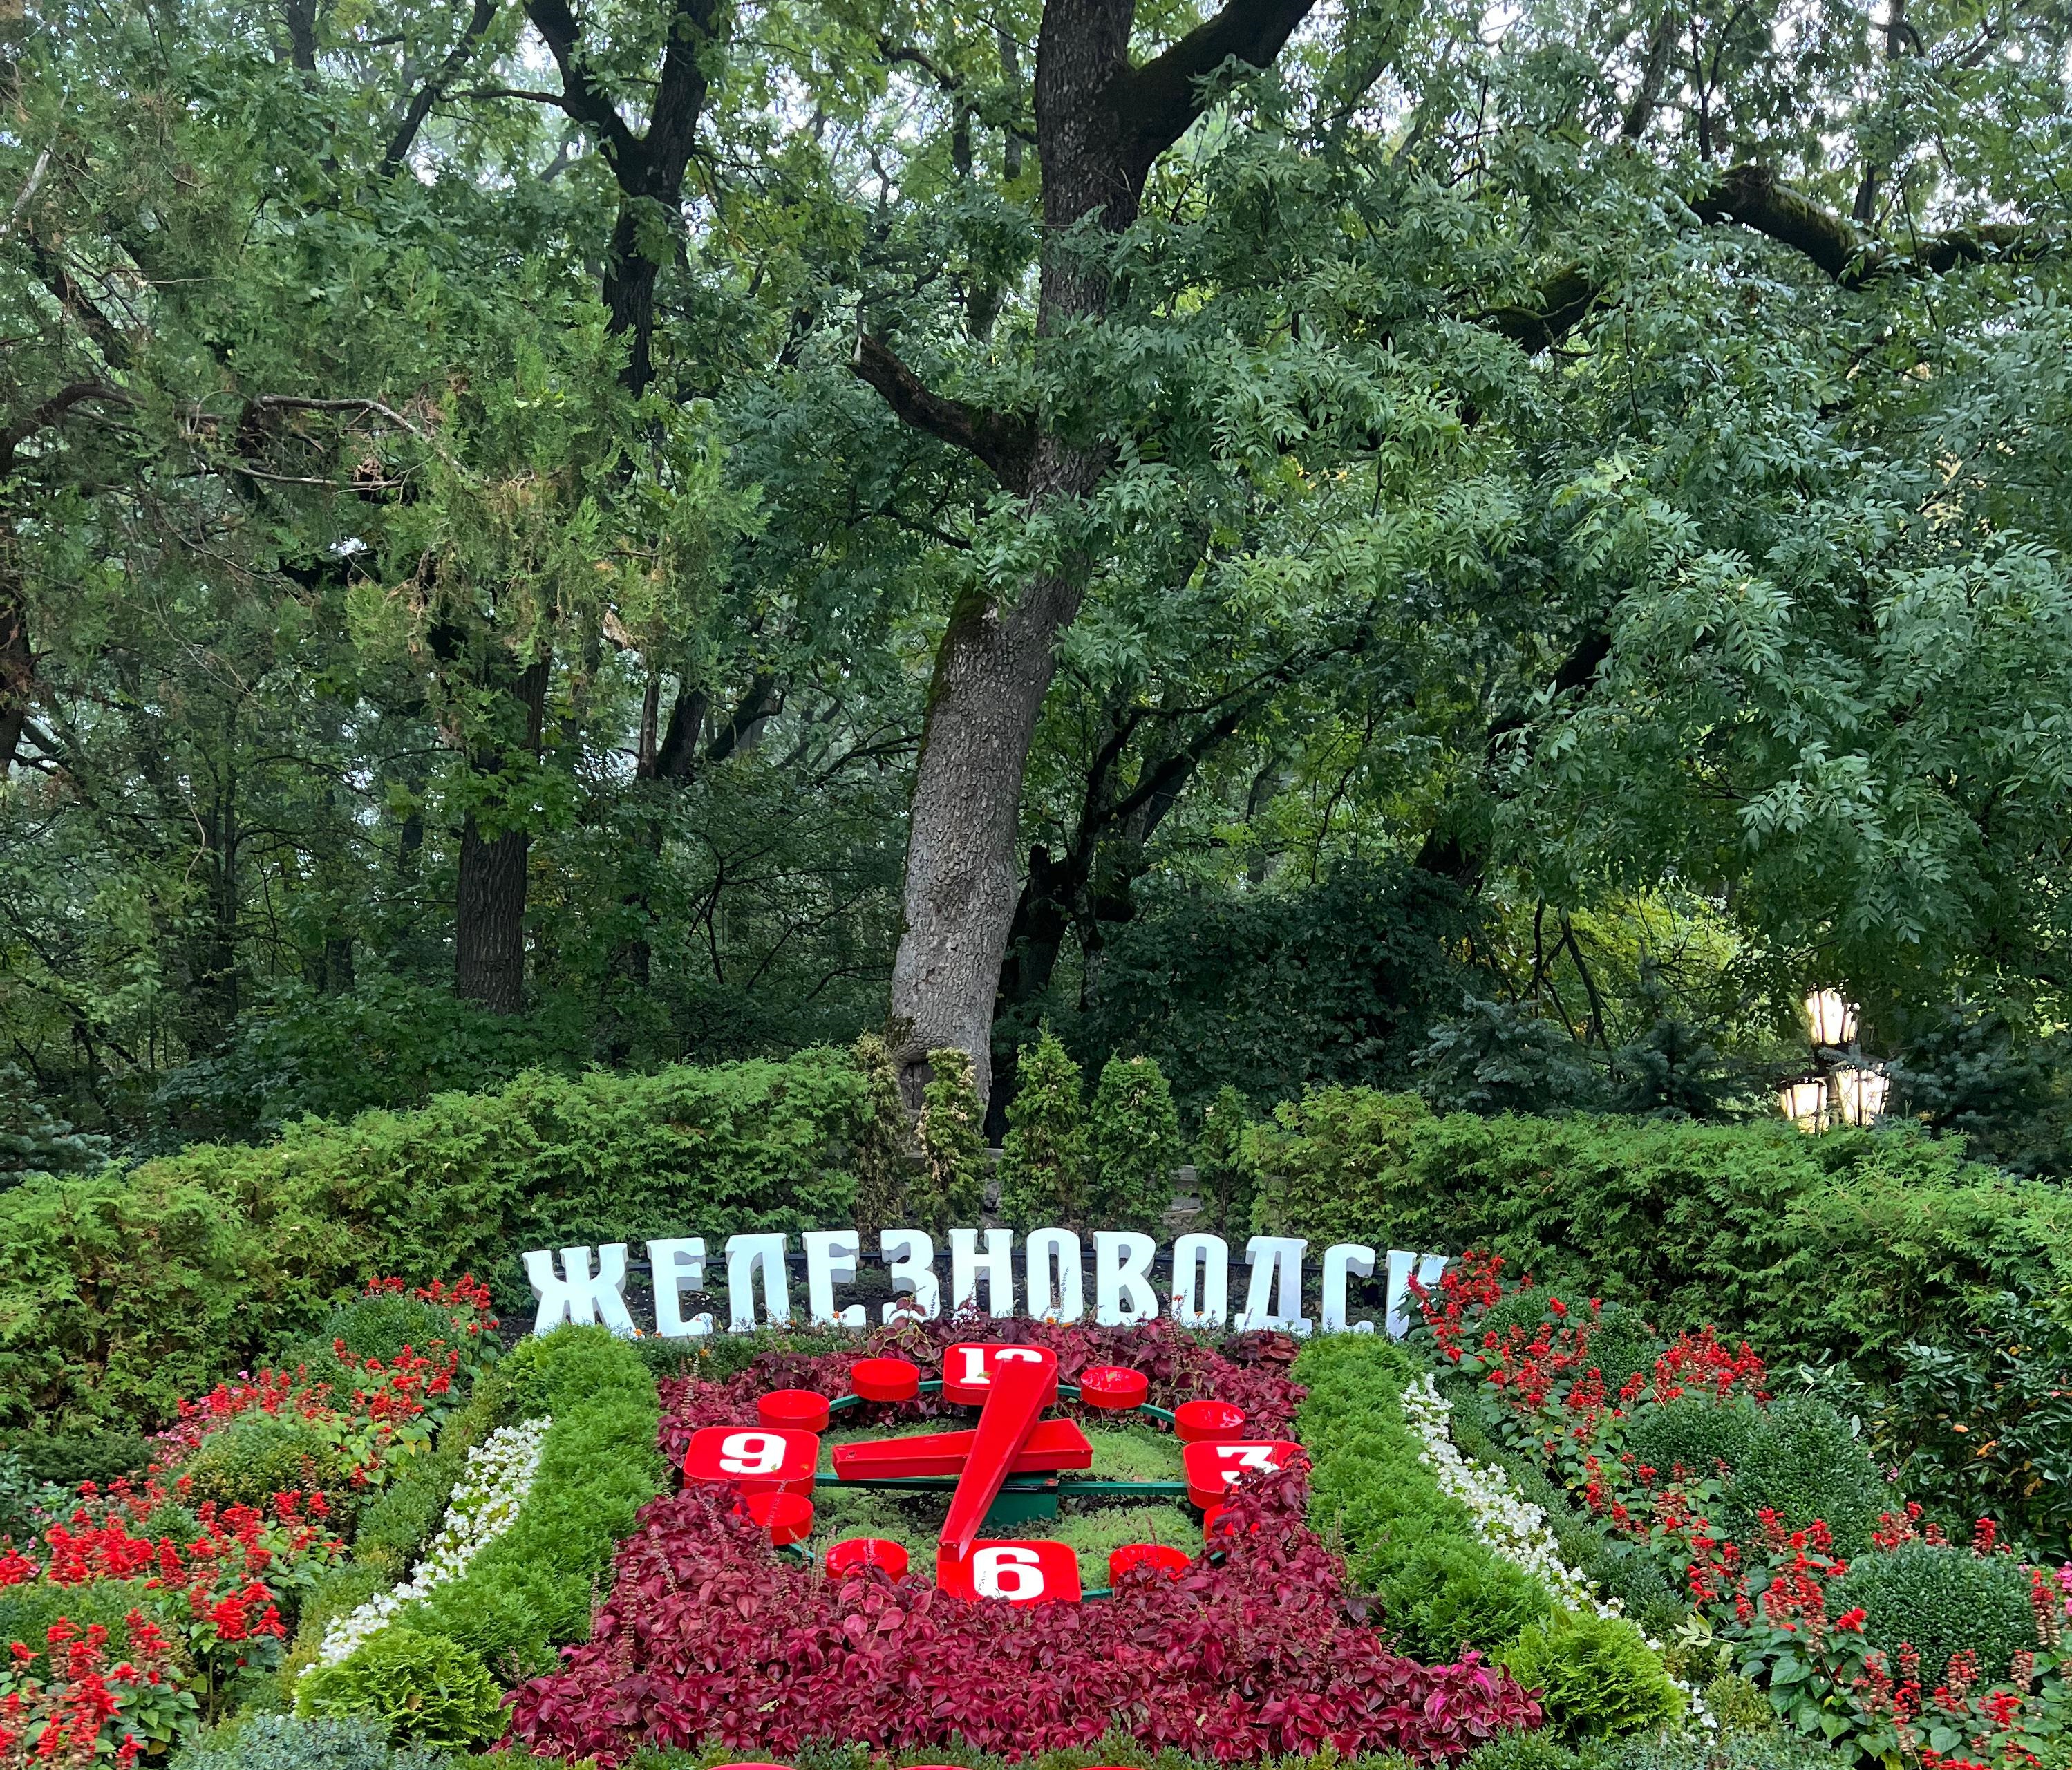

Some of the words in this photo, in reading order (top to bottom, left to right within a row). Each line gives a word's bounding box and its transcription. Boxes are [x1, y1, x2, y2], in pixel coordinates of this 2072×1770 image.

[719, 1433, 787, 1474] 9
[1216, 1446, 1280, 1485] 3
[973, 1547, 1044, 1601] 6
